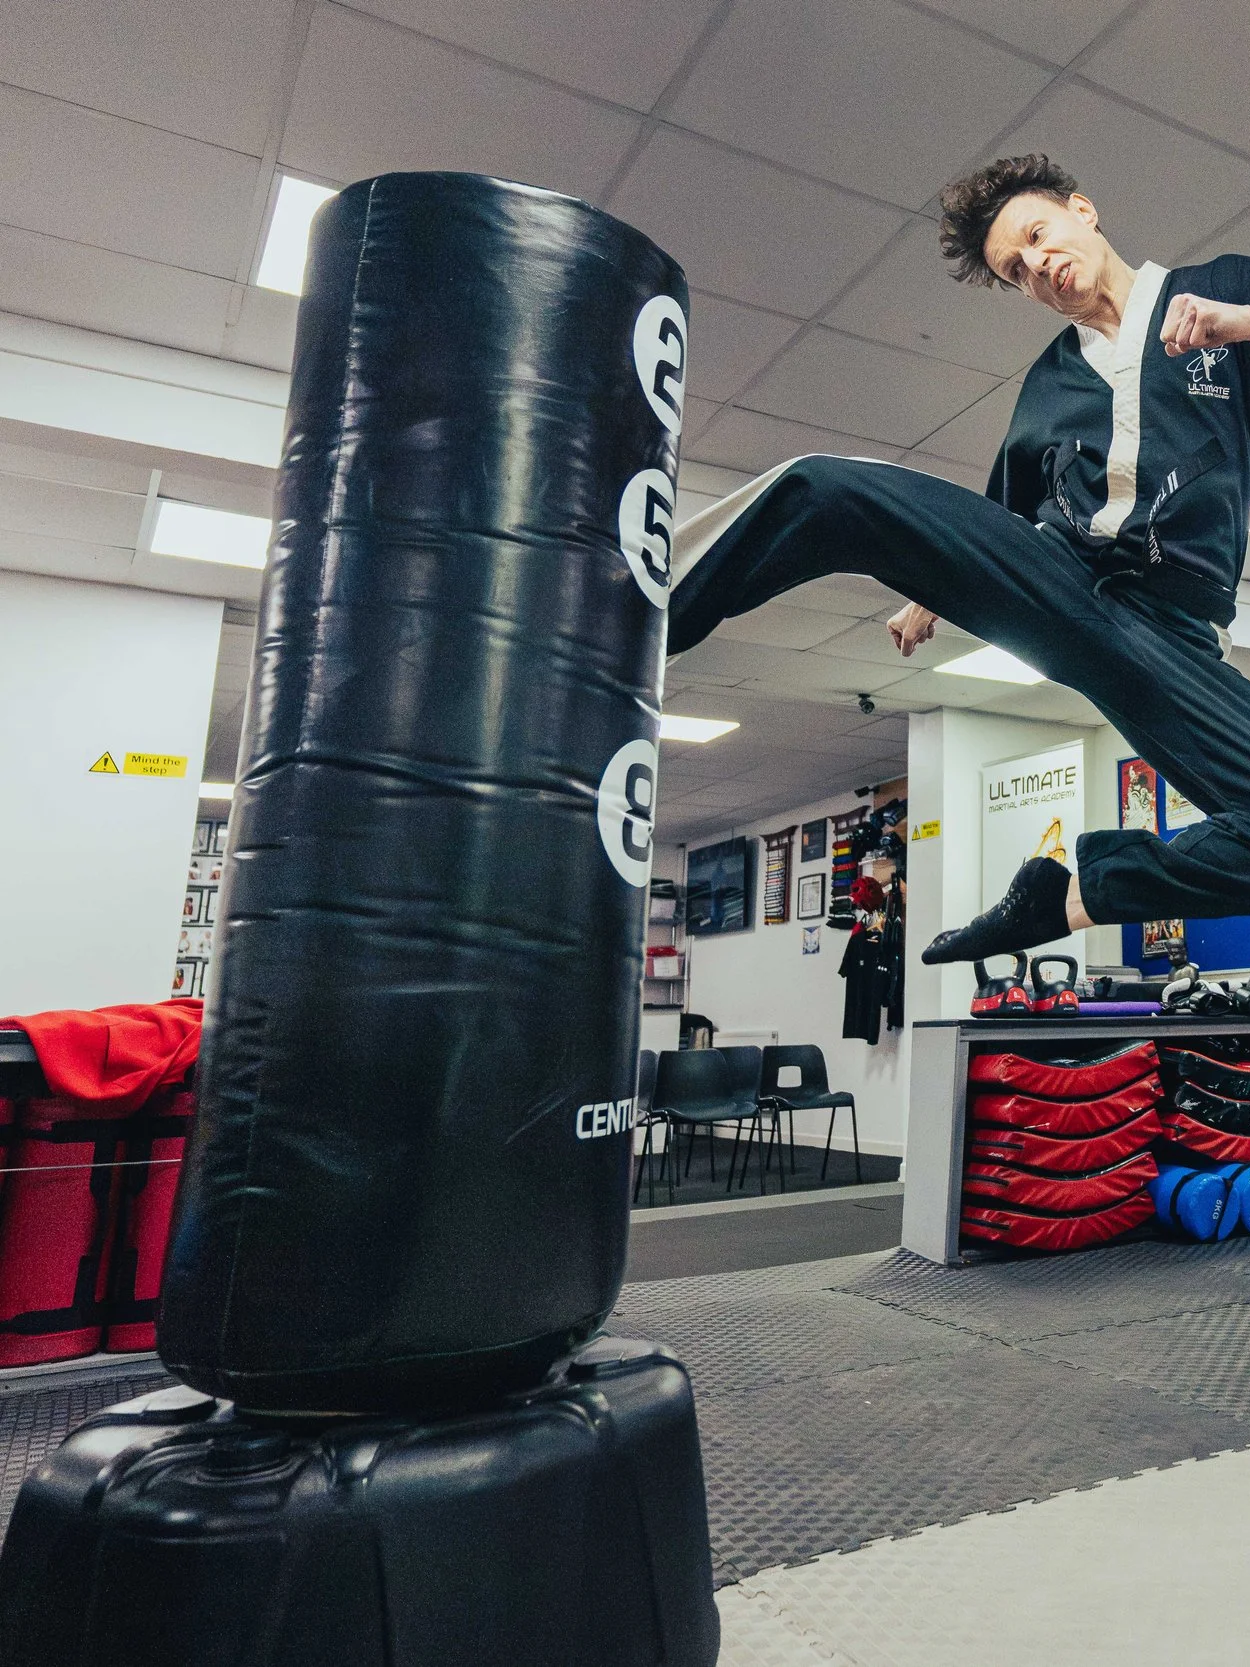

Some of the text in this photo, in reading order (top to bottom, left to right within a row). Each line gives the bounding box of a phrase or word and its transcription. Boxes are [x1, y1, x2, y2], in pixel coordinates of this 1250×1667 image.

[653, 317, 684, 421] 2
[1187, 383, 1230, 395] ULTIMATE
[641, 485, 672, 587] 5
[131, 755, 181, 766] Mind the
[142, 765, 167, 776] step
[989, 766, 1076, 801] ULTIMATE
[622, 763, 654, 862] 8
[988, 789, 1076, 813] MARTIAL ARTS ACADEMY
